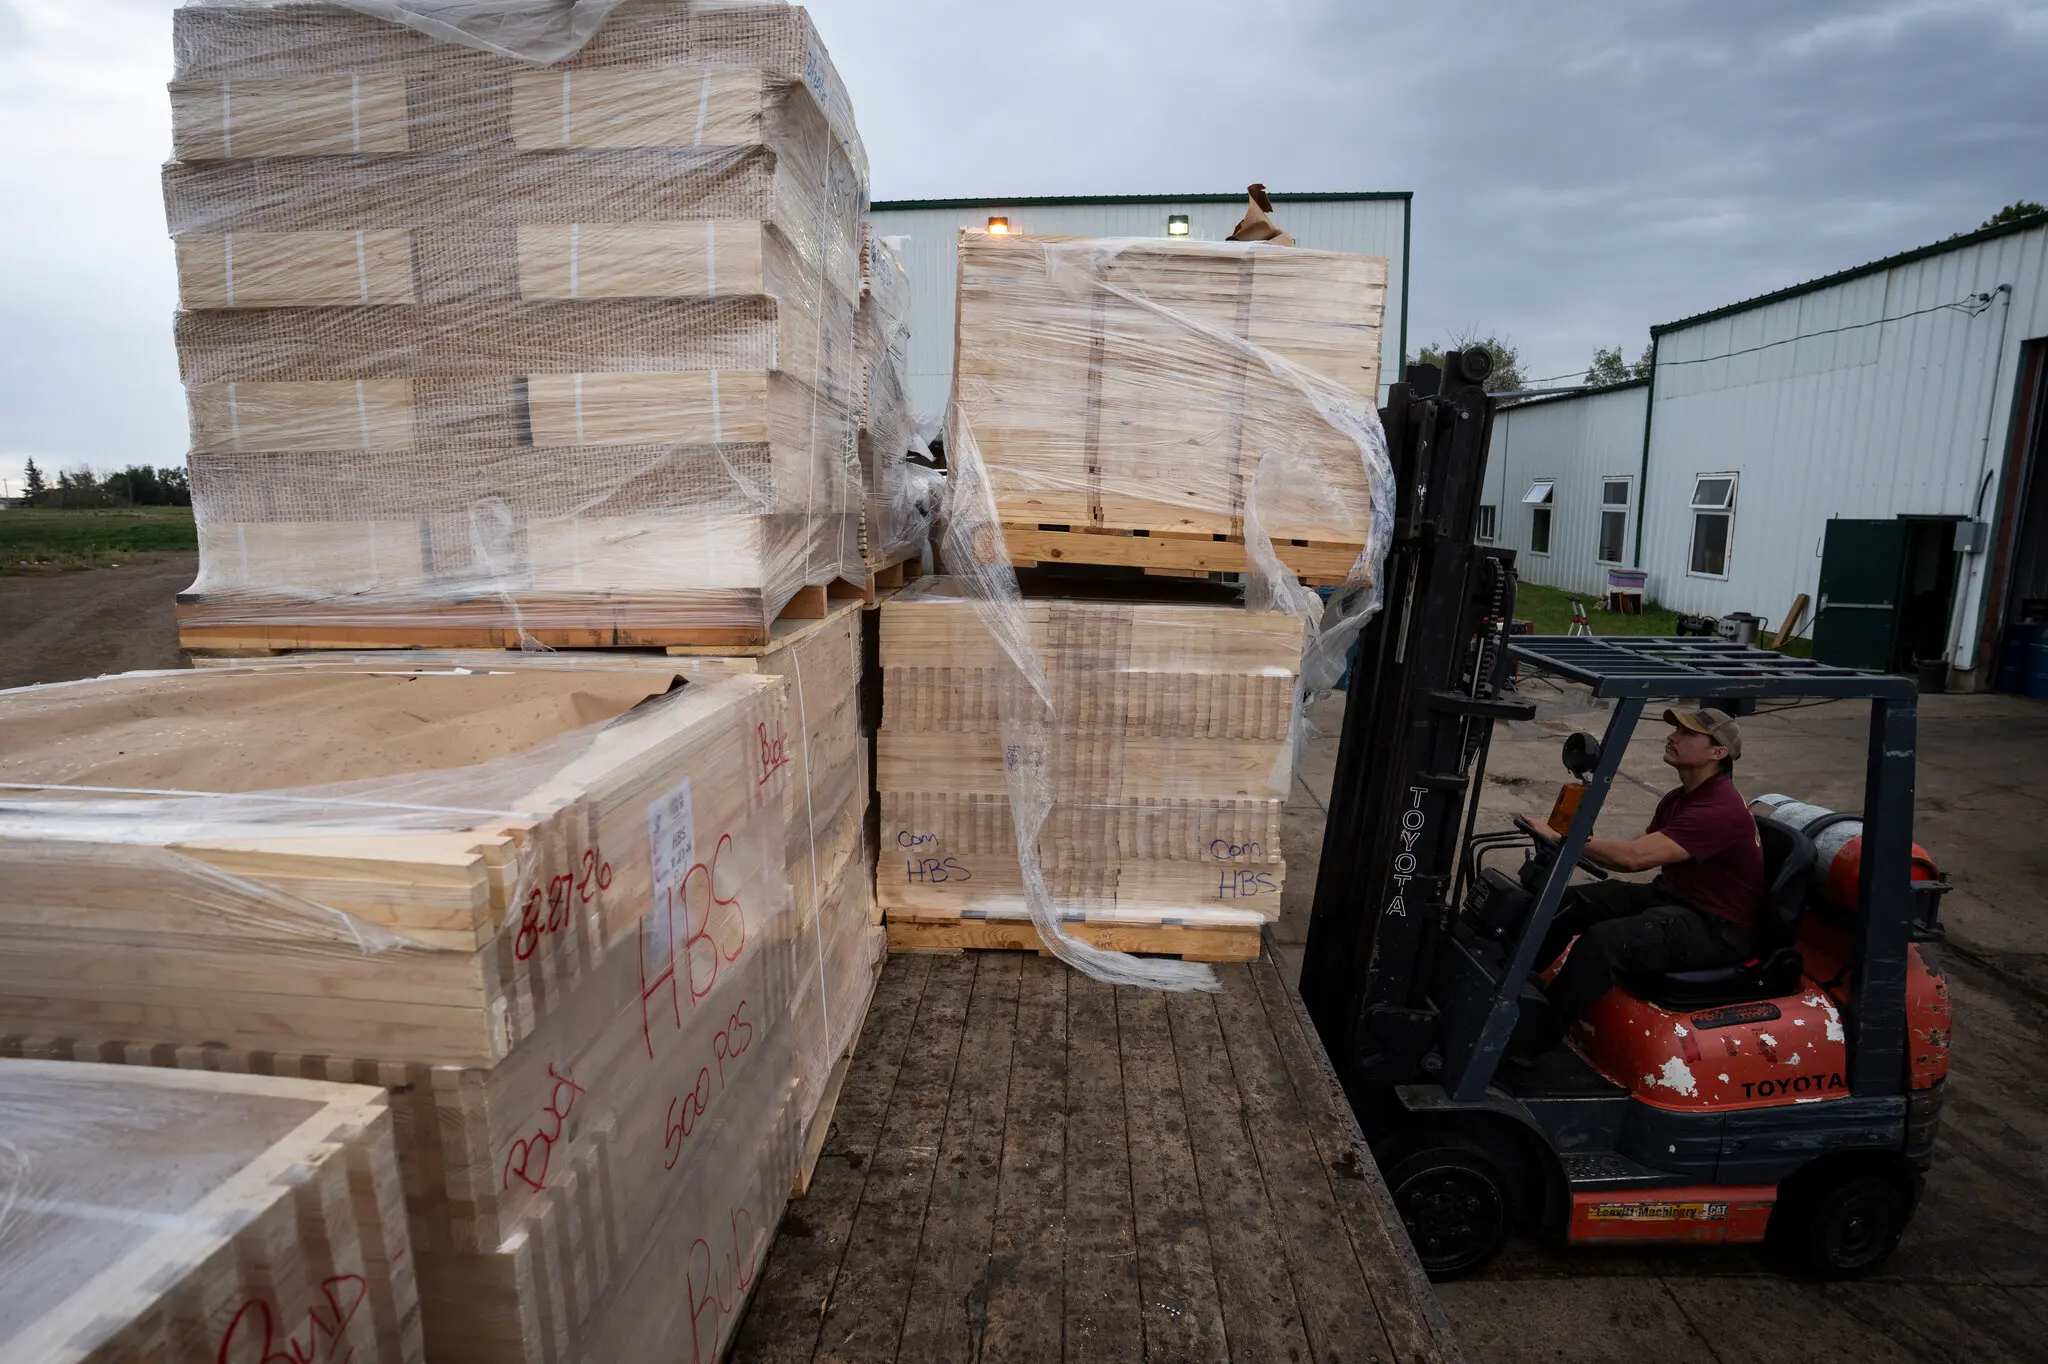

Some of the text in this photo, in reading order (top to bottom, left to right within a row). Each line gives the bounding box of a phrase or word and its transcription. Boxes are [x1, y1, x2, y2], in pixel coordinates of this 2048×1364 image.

[897, 830, 939, 848] Com
[1210, 839, 1262, 860] Com
[1386, 786, 1429, 917] TOYOTA
[907, 857, 972, 884] HBS
[1218, 869, 1277, 899] HBS
[639, 833, 745, 1061] HBS
[665, 999, 753, 1170] 500 PCS
[1741, 1072, 1844, 1098] TOYOTA
